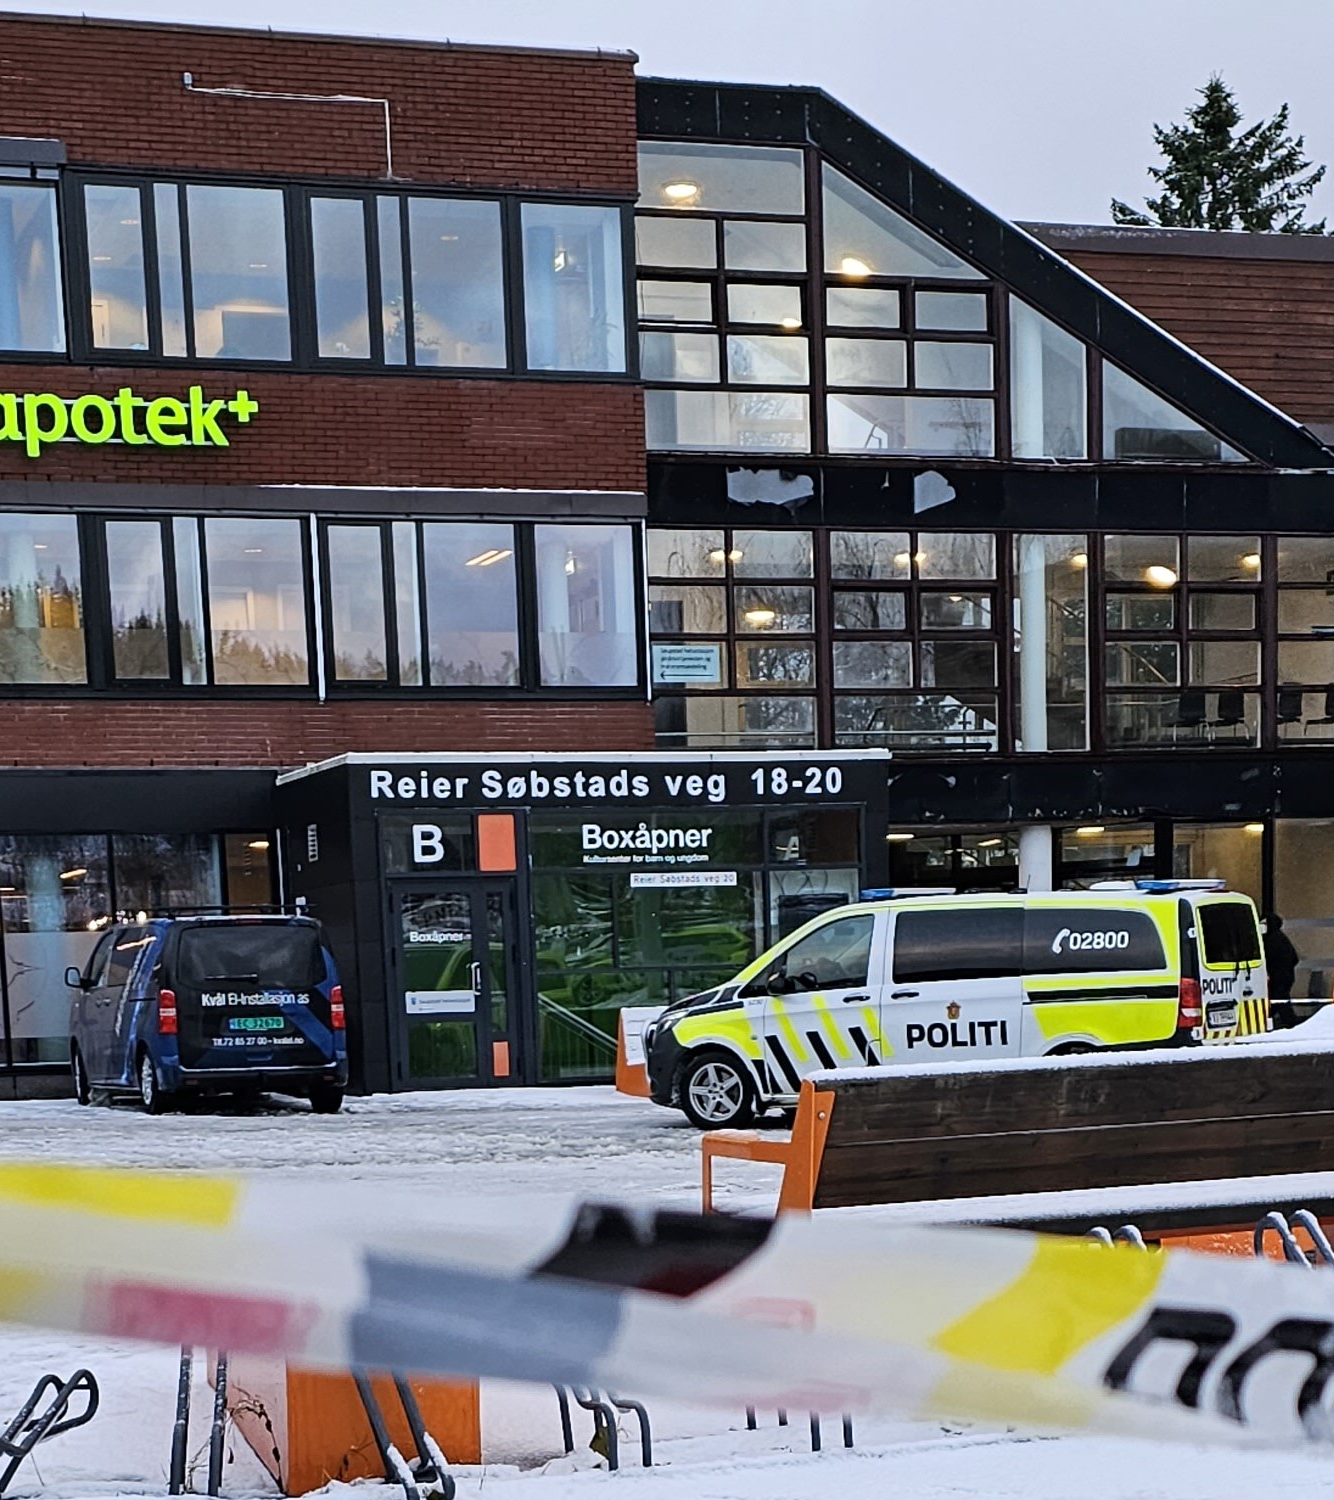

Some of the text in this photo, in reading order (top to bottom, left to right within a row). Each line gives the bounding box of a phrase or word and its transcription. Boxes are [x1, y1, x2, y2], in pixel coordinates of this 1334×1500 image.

[370, 766, 843, 802] Reier Søbstads veg 18-20
[412, 824, 445, 863] B
[581, 822, 713, 853] Boxåpner
[633, 875, 656, 884] Reier
[410, 930, 463, 944] Boxåpner
[1069, 931, 1129, 950] 02800
[201, 992, 226, 1006] Kvål
[297, 993, 310, 1004] as
[906, 1020, 1008, 1049] POLITI
